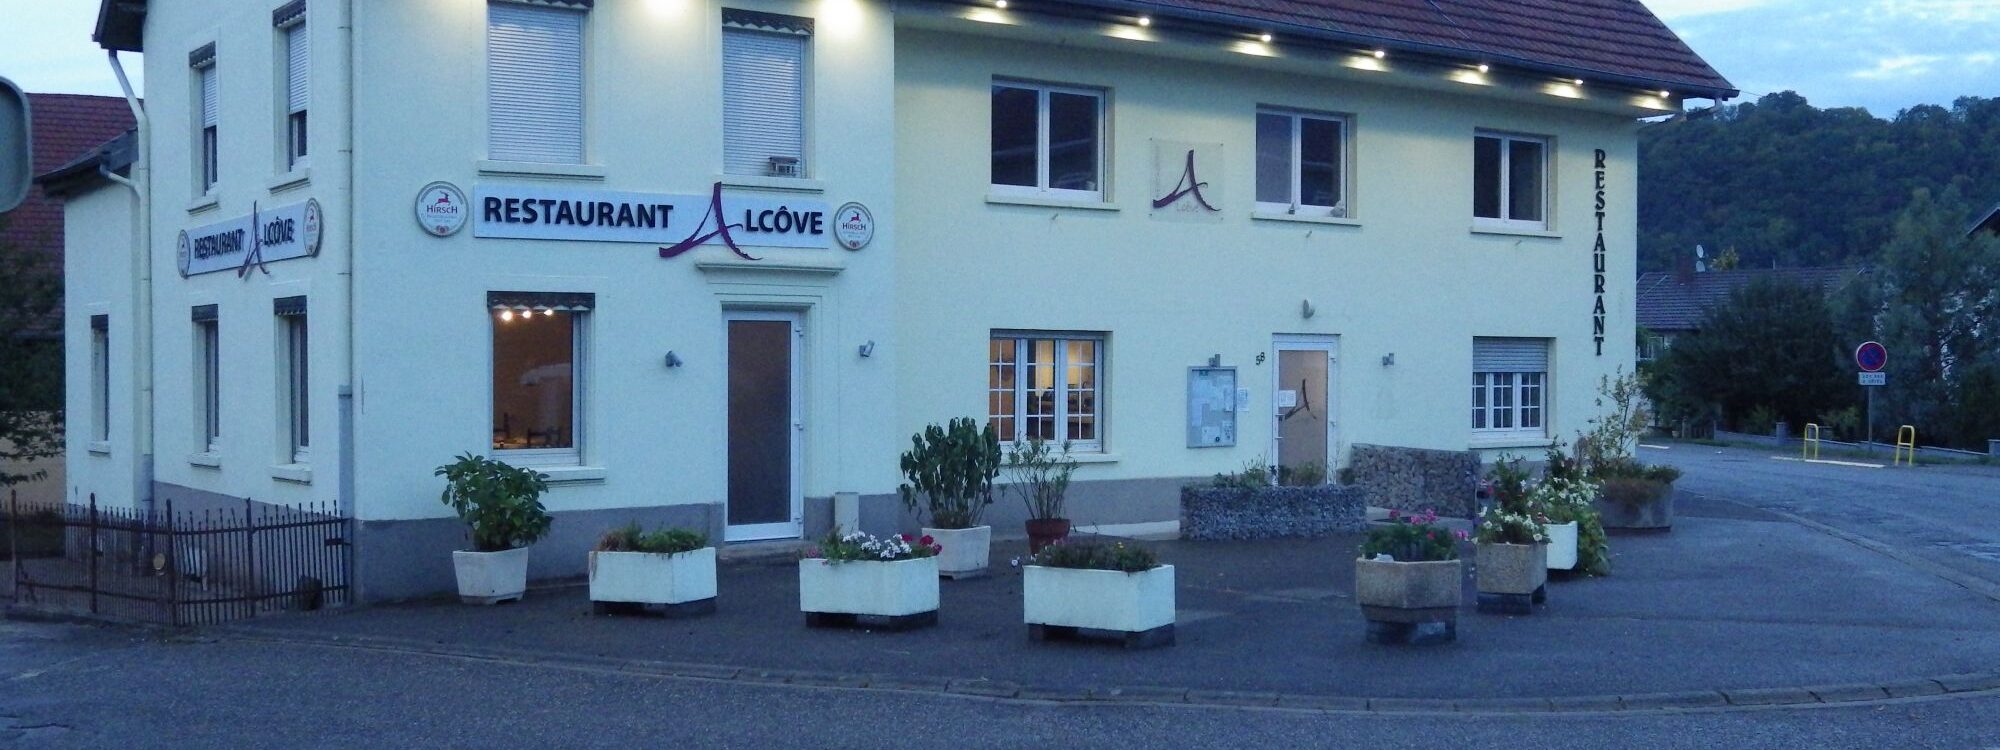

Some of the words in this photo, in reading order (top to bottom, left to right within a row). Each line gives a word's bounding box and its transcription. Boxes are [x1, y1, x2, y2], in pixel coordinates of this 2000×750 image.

[483, 196, 674, 229] RESTAURANT
[193, 228, 246, 260] RESTAURANT
[1593, 148, 1606, 357] RESTAURANT
[1255, 351, 1266, 366] 58
